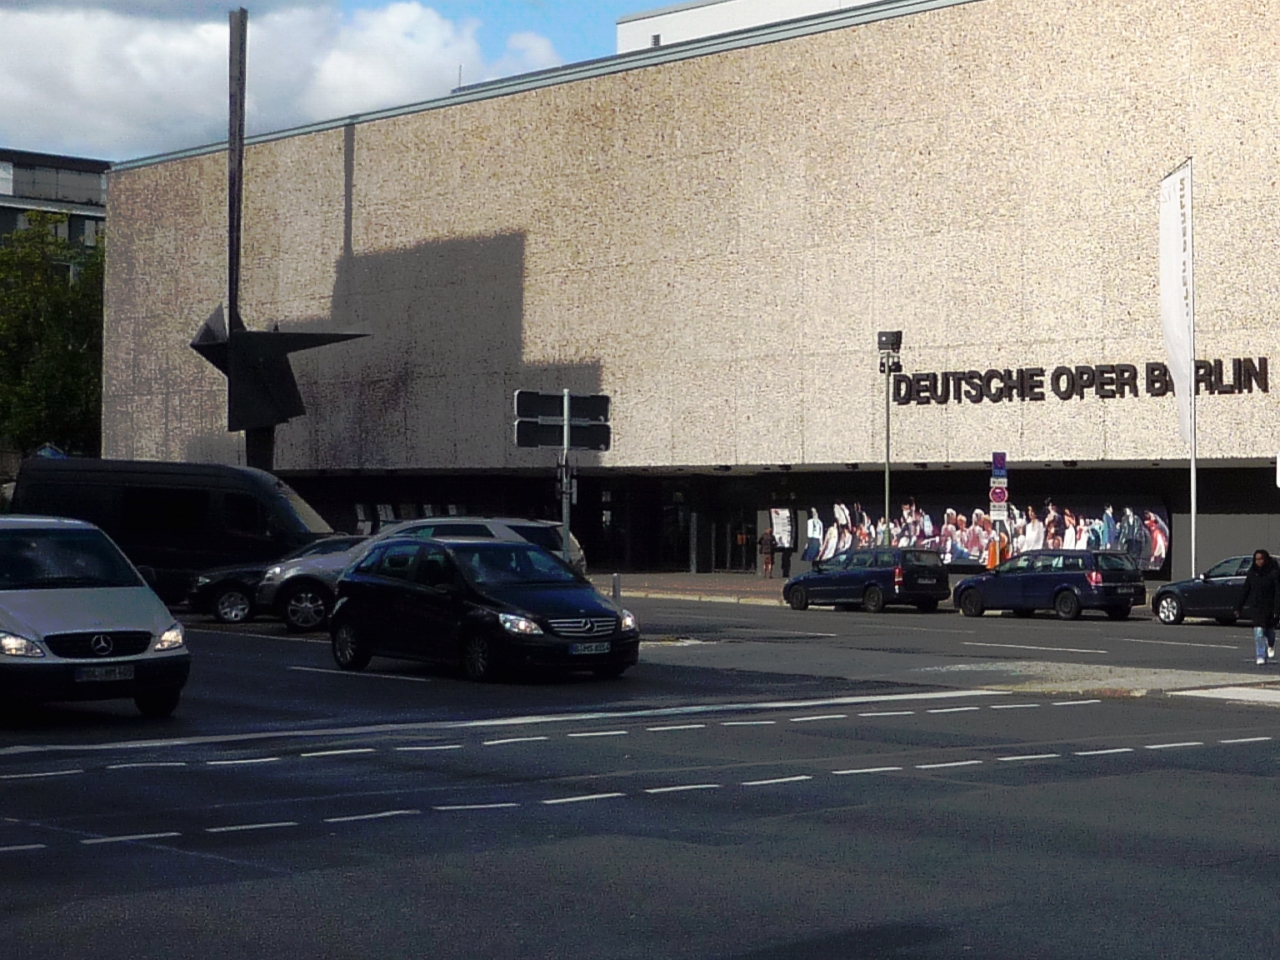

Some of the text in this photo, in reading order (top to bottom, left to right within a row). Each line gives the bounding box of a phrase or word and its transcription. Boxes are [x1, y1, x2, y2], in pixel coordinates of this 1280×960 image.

[893, 357, 1269, 405] DEUTSCHE OPER BRLIN
